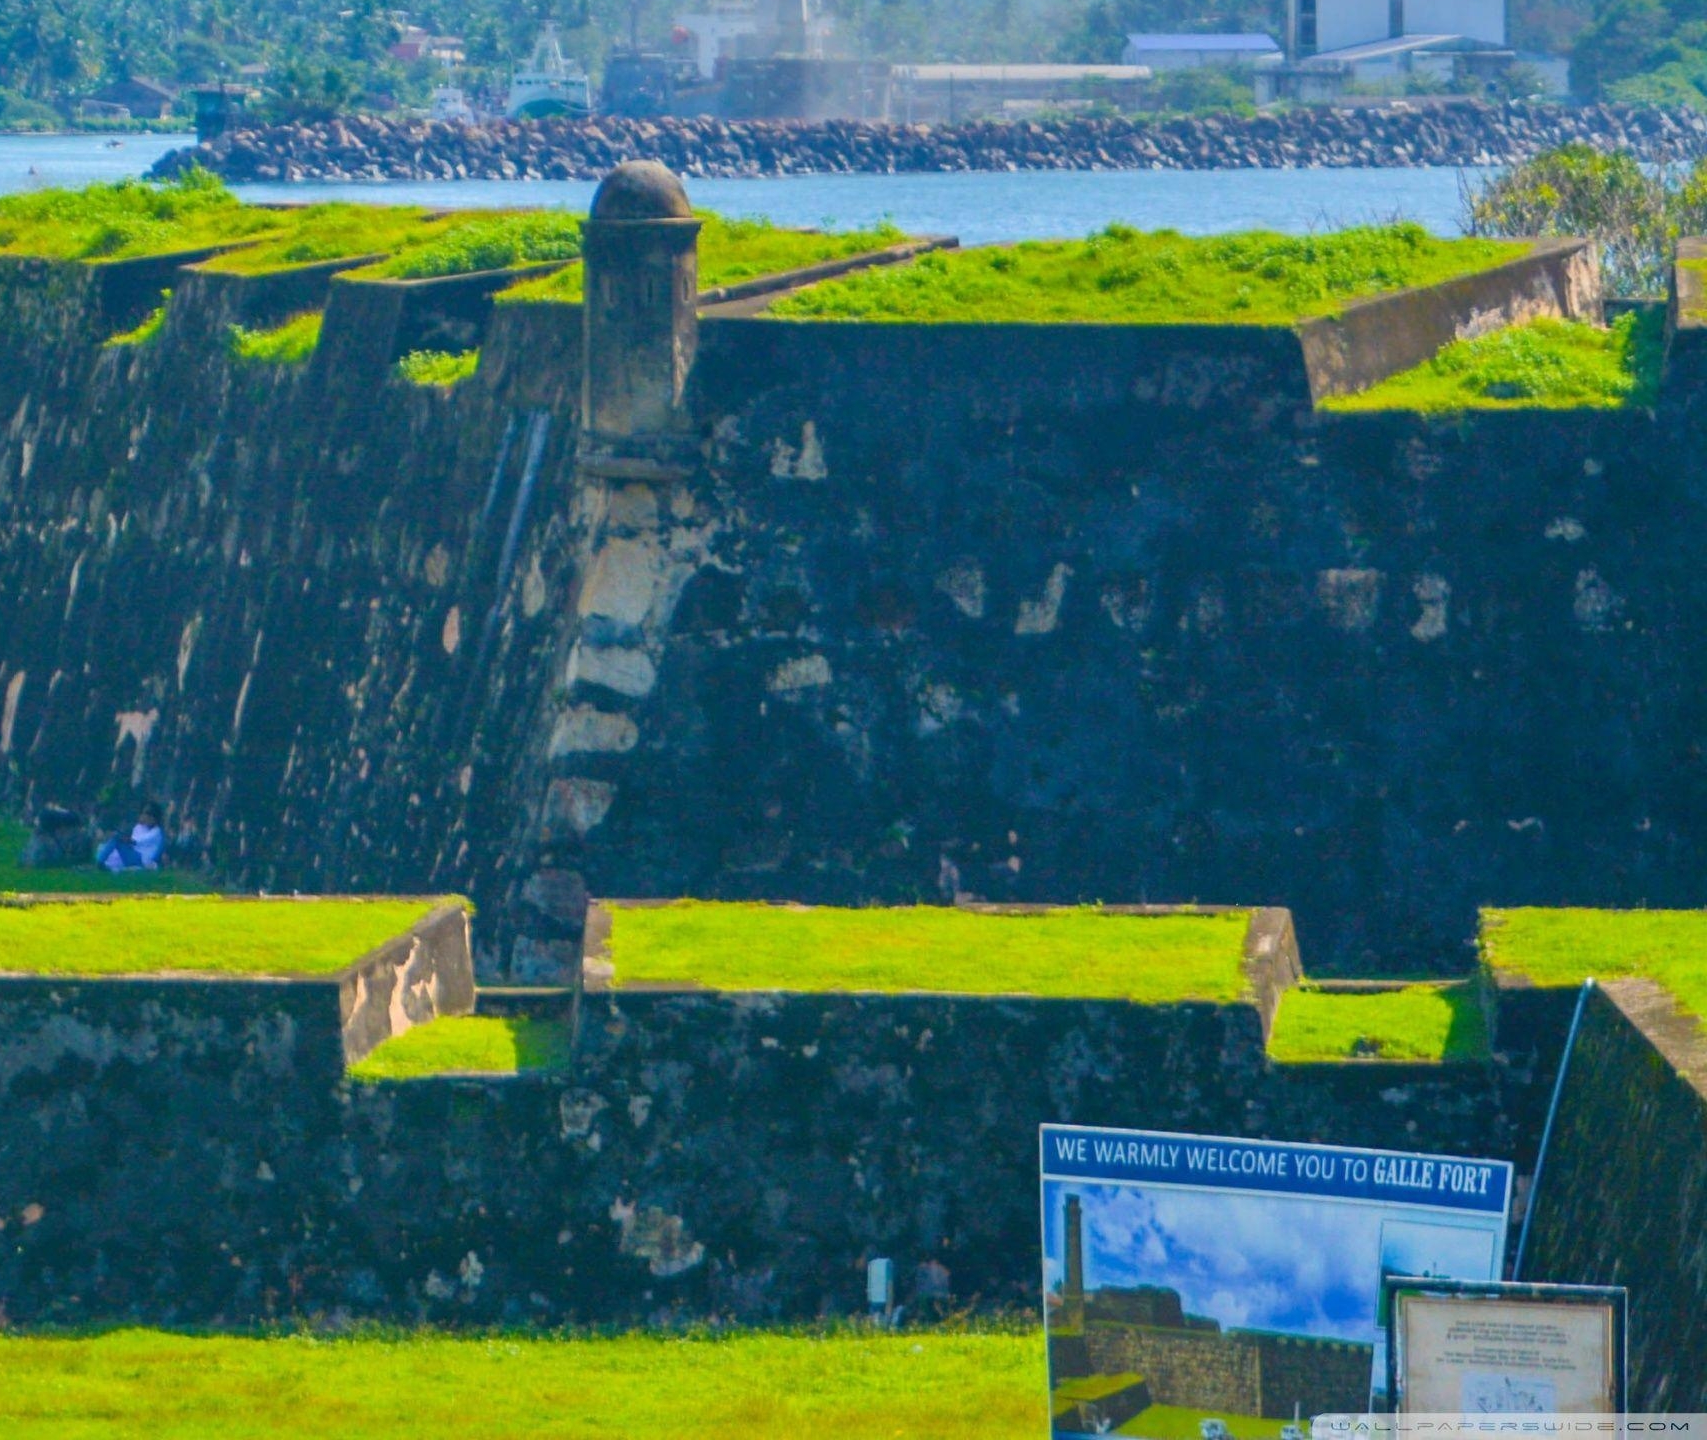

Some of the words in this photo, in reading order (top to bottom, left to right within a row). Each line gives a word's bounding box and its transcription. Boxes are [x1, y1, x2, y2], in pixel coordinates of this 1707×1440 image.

[1055, 1137, 1087, 1161] WE
[1094, 1140, 1180, 1168] WARMLY
[1186, 1146, 1288, 1176] WELCOME
[1294, 1154, 1335, 1180] YOU
[1342, 1158, 1368, 1182] TO
[1374, 1157, 1434, 1189] GALLE
[1438, 1163, 1492, 1195] FORT
